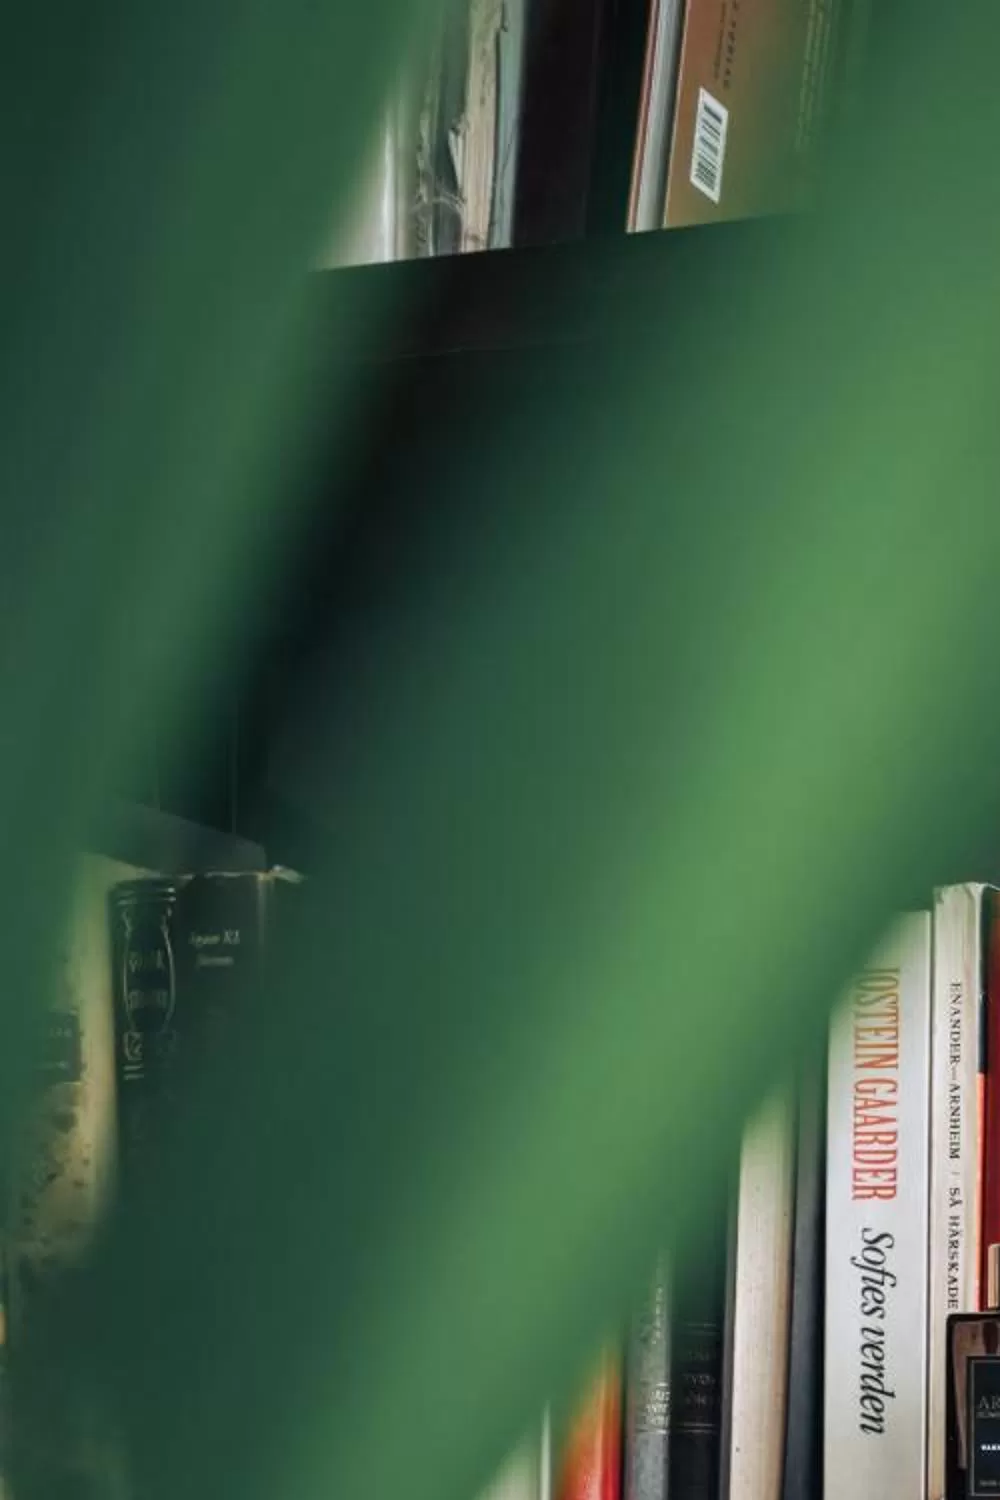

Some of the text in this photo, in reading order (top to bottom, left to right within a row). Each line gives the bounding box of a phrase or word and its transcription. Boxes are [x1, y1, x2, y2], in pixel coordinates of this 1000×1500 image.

[852, 1077, 898, 1201] GAARDER
[850, 1227, 897, 1435] Sofies verden
